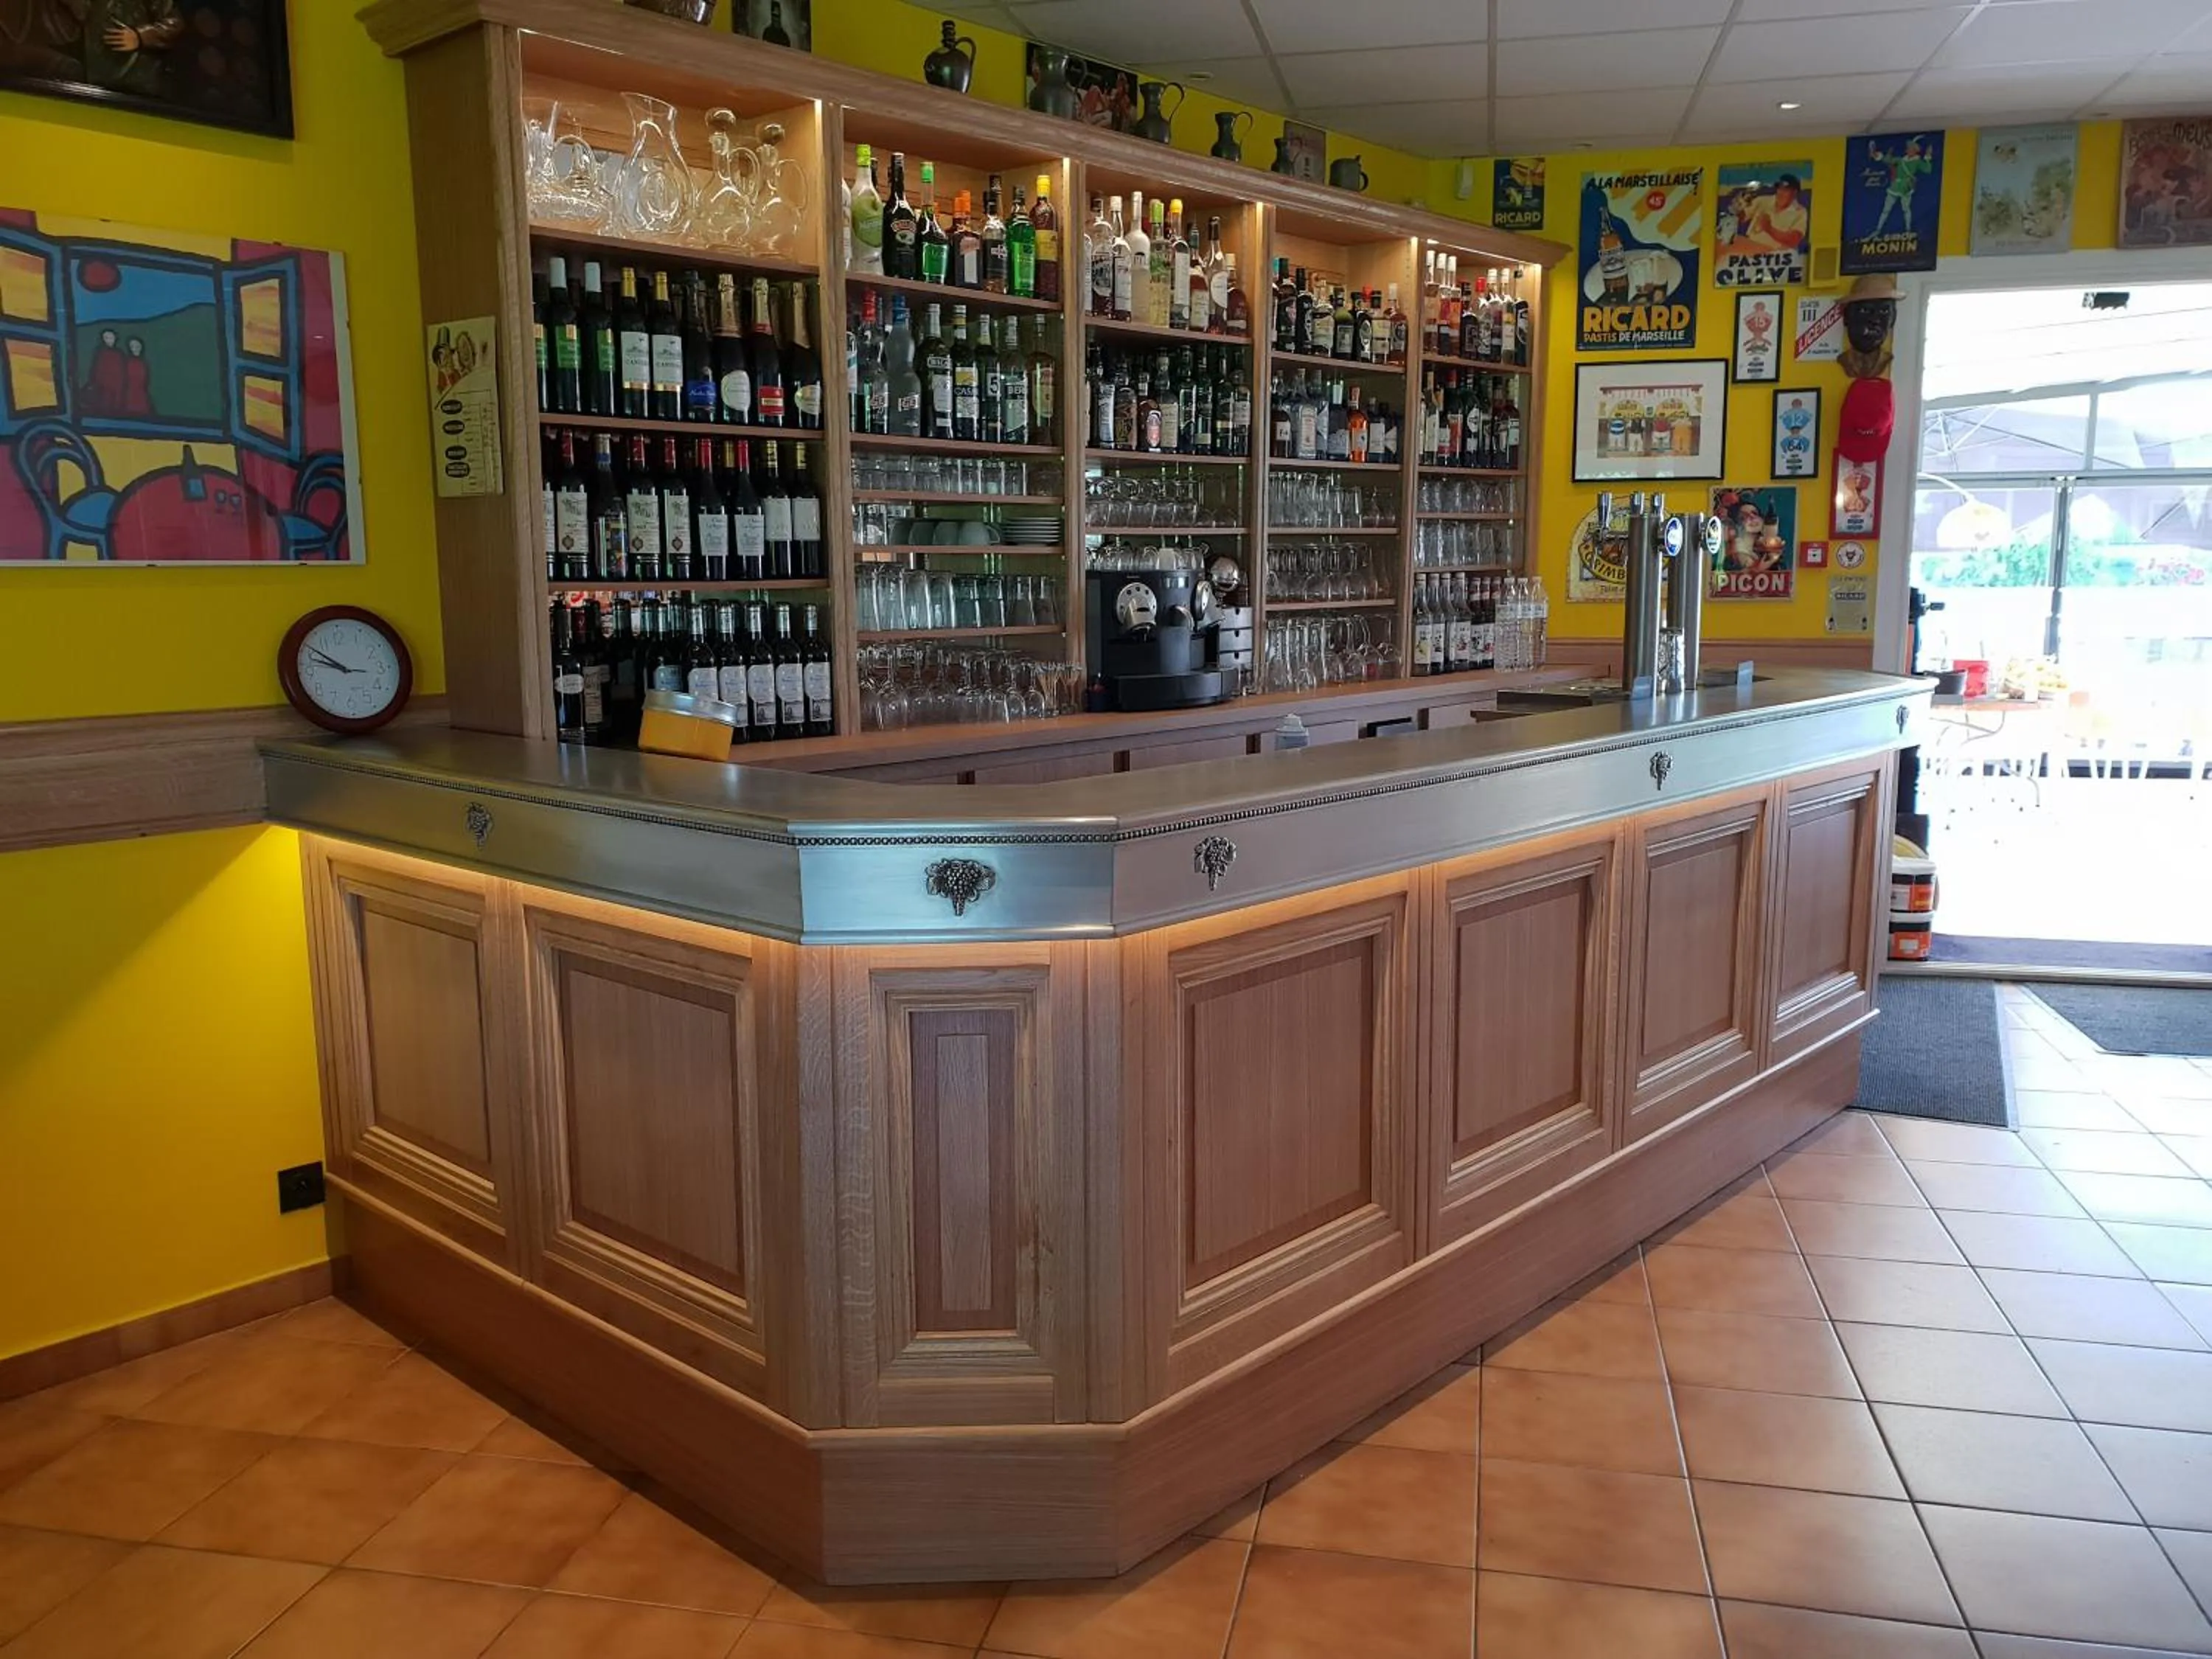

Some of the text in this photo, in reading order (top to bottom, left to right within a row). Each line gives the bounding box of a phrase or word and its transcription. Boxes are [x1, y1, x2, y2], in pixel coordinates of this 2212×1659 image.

[2174, 122, 2212, 150] MEUS
[1599, 175, 1613, 188] LA
[1495, 211, 1542, 223] RICARD
[1862, 240, 1917, 255] MONIN
[1728, 253, 1793, 268] PASTIS
[1716, 266, 1802, 285] OLIVE
[1583, 304, 1691, 332] RICARD
[1583, 329, 1686, 343] PASTIS DE MARSEILLE
[1797, 305, 1843, 354] LICENCE
[1717, 573, 1785, 592] PICON
